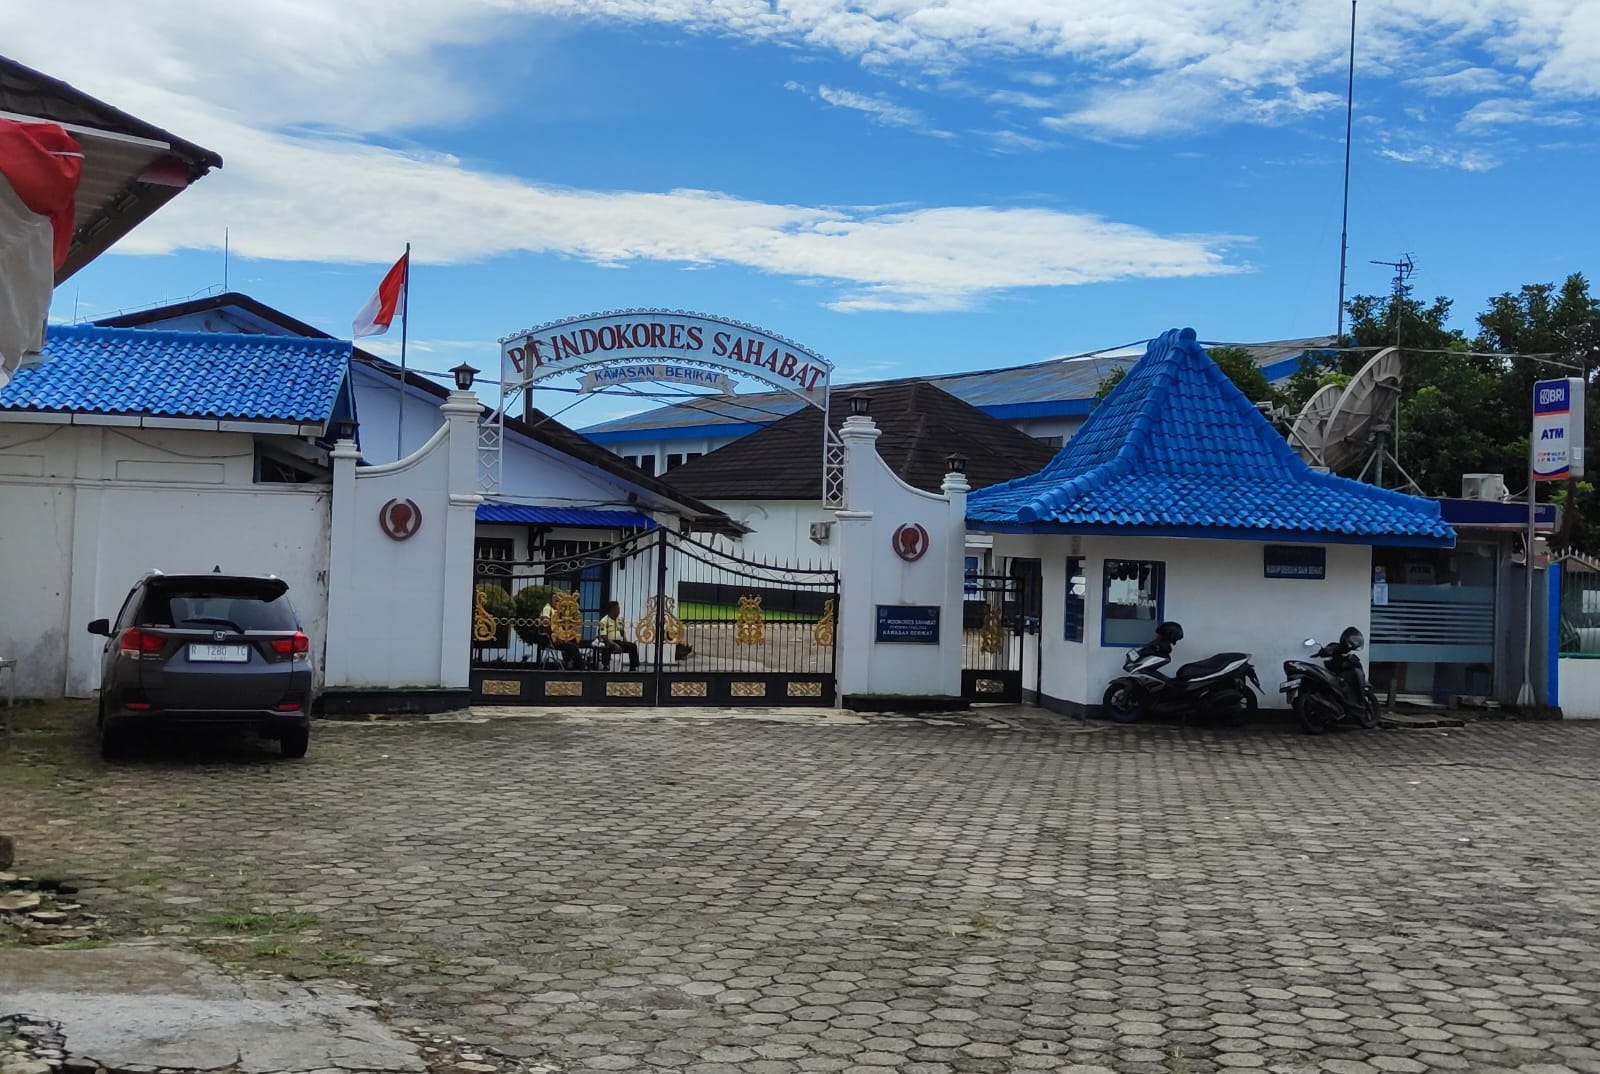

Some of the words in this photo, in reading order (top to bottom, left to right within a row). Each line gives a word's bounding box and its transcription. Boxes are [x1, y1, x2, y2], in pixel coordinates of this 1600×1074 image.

[712, 332, 825, 392] SAHABAT
[594, 366, 655, 382] KAWASAN
[665, 366, 720, 384] BERIKAT
[1541, 427, 1564, 441] ATM
[191, 645, 197, 656] R
